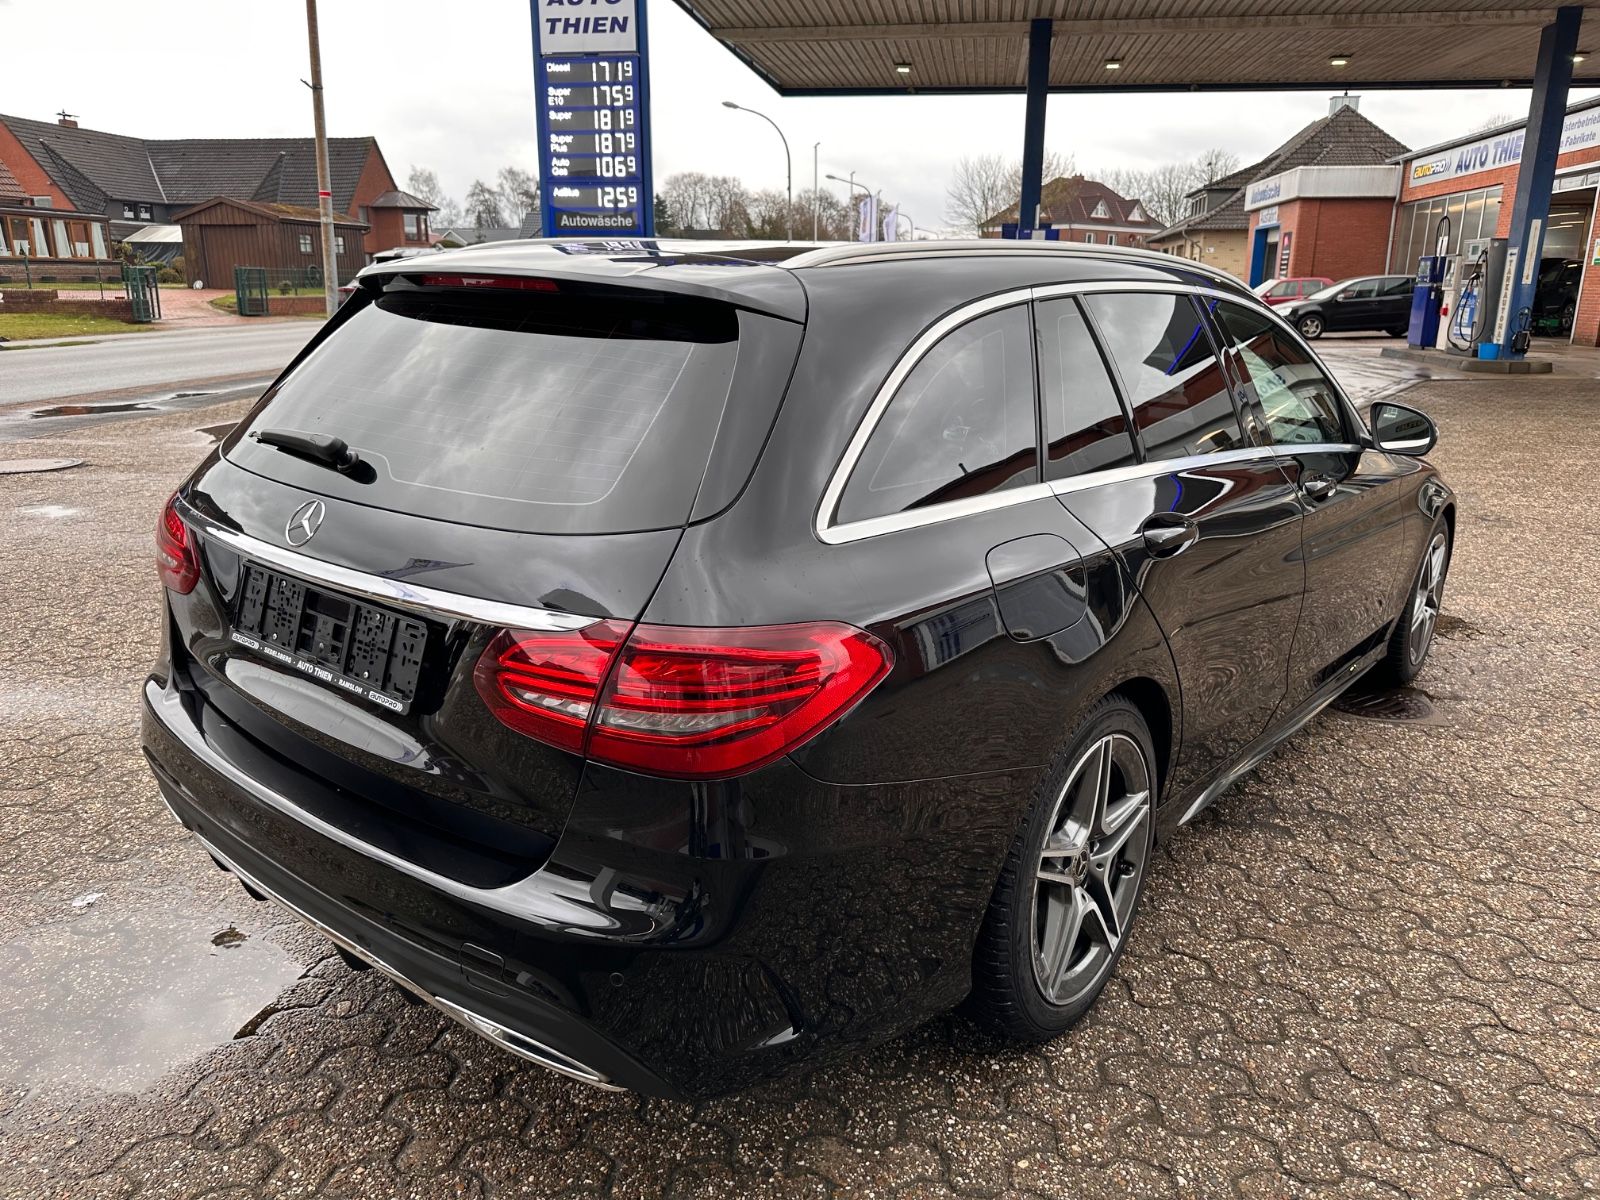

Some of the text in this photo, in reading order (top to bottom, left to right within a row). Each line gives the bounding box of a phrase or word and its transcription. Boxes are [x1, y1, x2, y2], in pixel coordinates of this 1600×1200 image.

[546, 16, 629, 35] THIEN
[546, 61, 633, 82] Diesel 1719
[547, 85, 633, 106] Super 1759
[548, 97, 564, 106] E10
[549, 109, 634, 130] Super 1819
[1564, 114, 1600, 132] isterbetrieb
[550, 133, 635, 154] Super 1879
[550, 144, 568, 153] Plus
[1565, 131, 1597, 147] Fabrikate
[1455, 145, 1488, 174] AUTO
[1492, 134, 1525, 166] THIE
[552, 156, 636, 177] Auto 1069
[597, 186, 637, 208] 1259
[560, 214, 633, 227] Autowäsche
[297, 660, 314, 674] AUTO
[314, 667, 333, 682] THIEN
